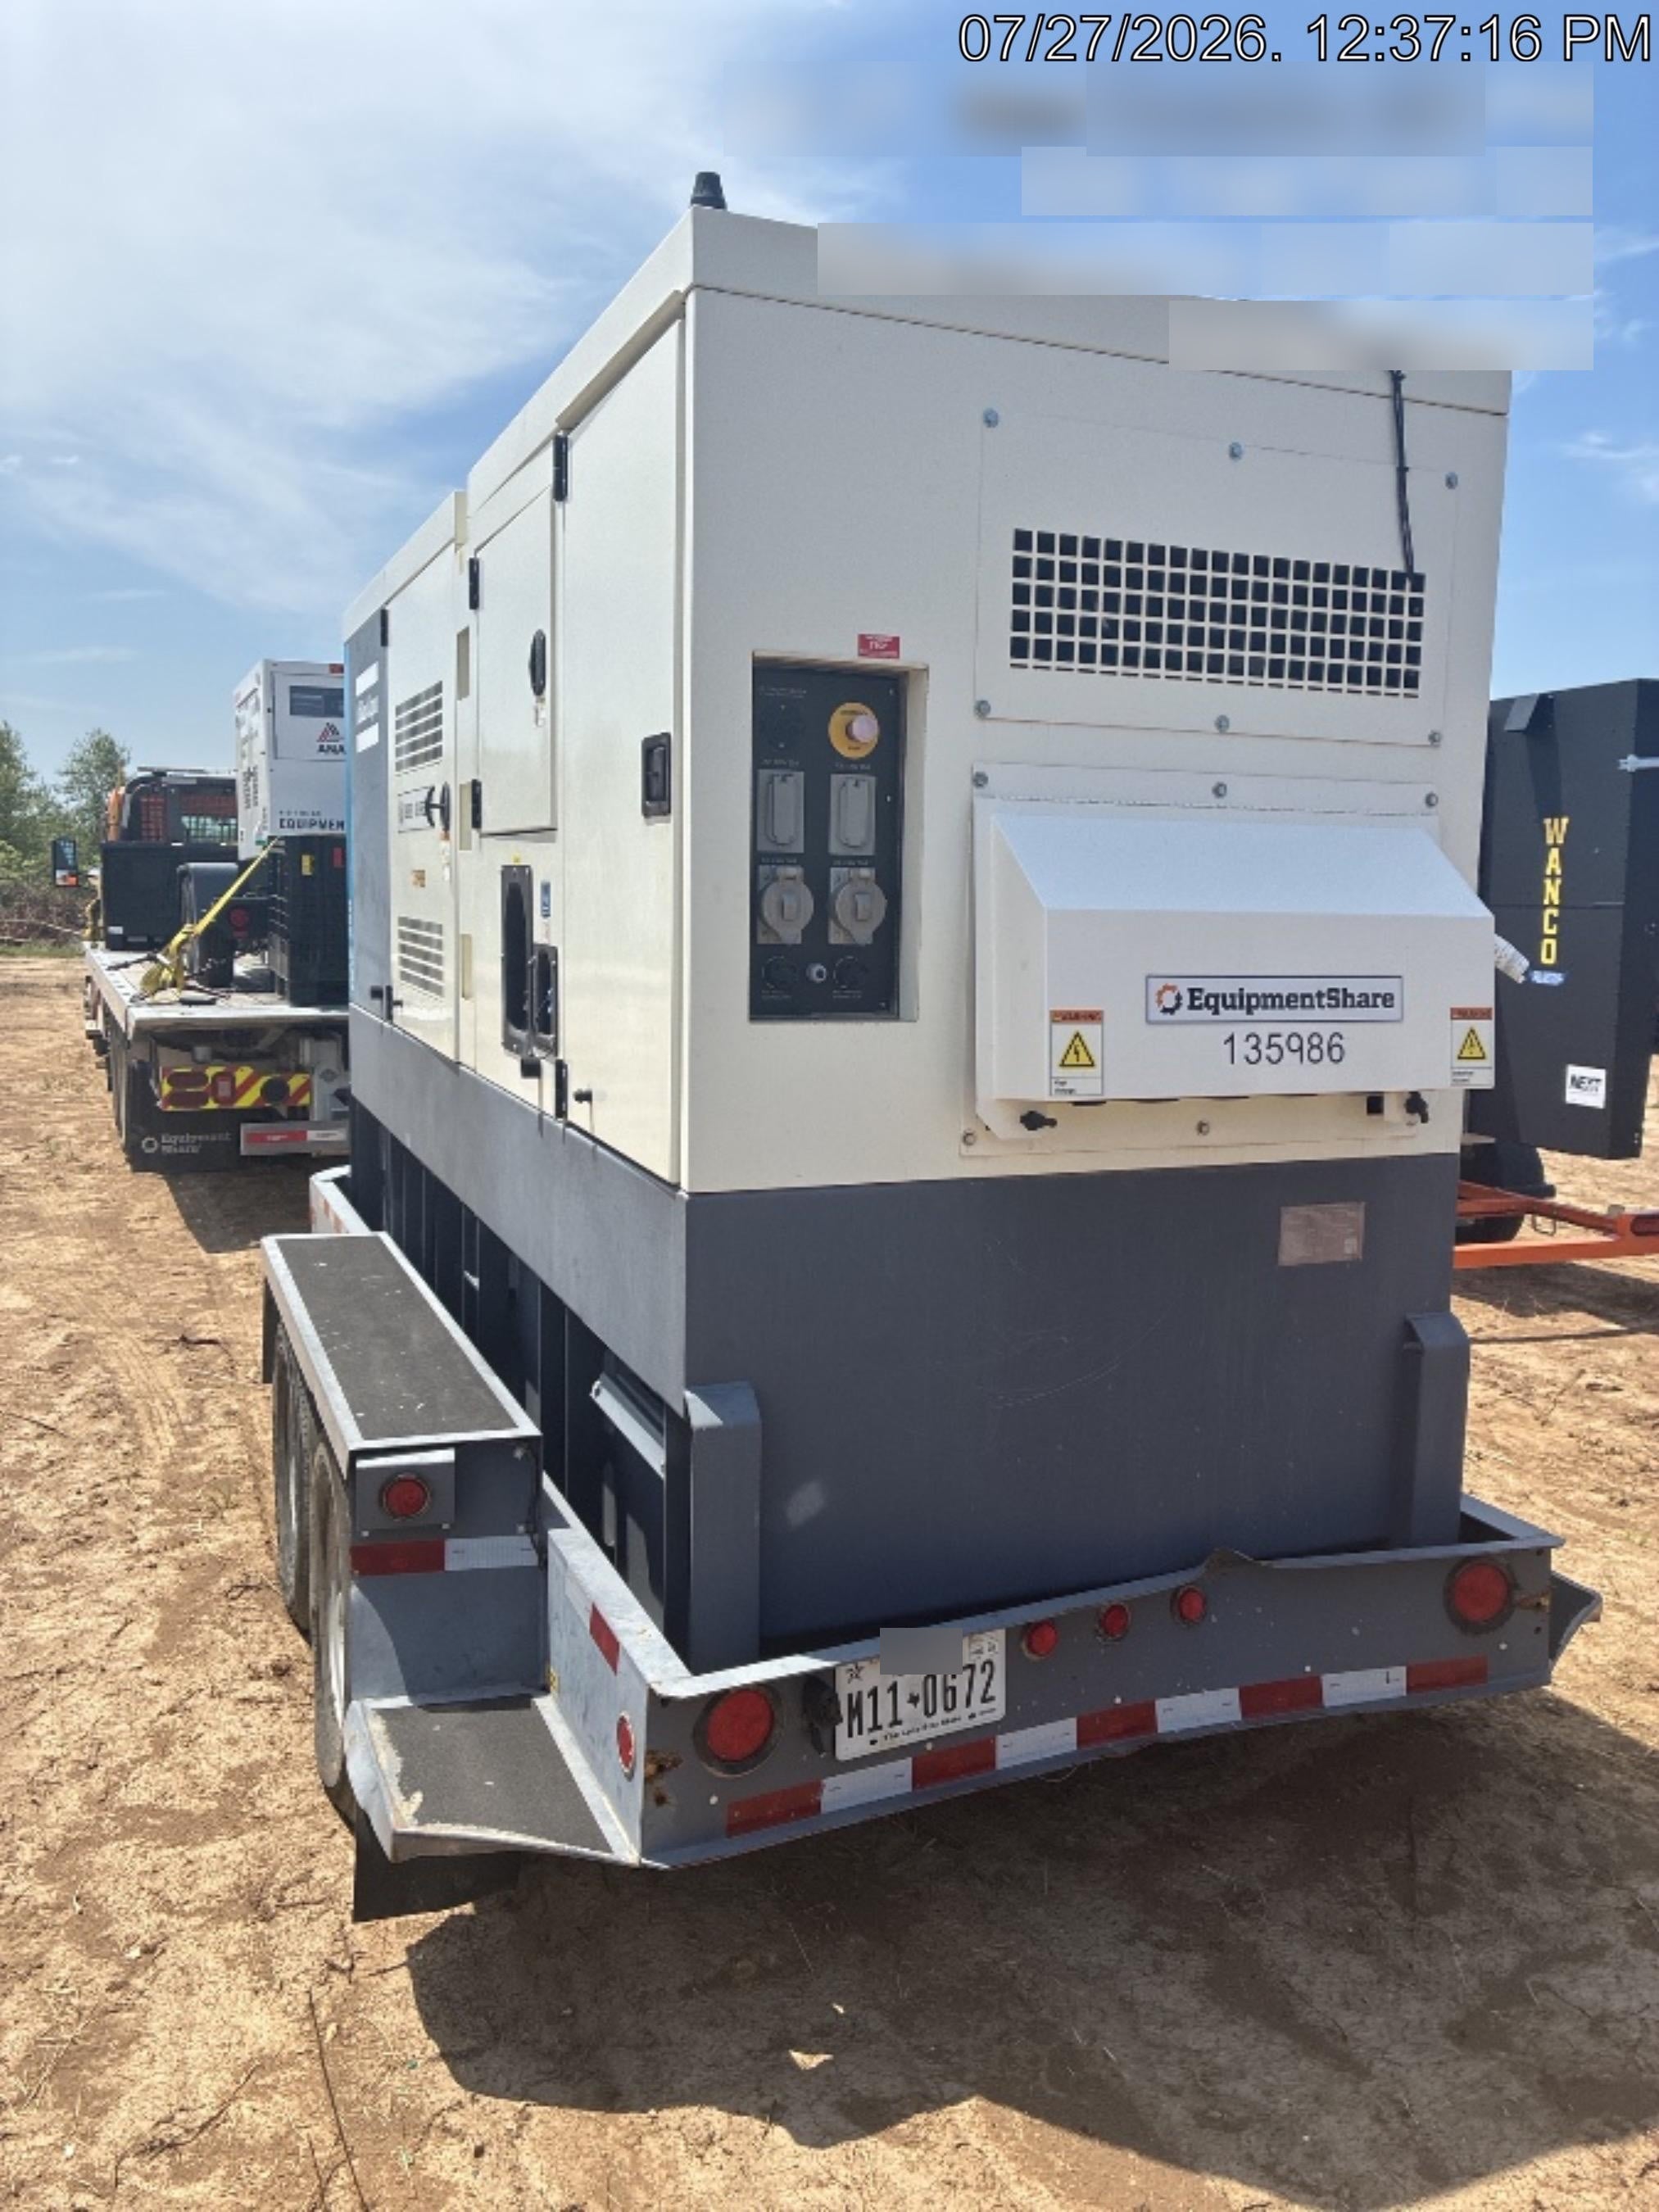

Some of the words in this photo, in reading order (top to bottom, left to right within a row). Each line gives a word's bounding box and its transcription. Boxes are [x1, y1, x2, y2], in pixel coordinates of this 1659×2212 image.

[1539, 816, 1570, 965] WANCO
[1186, 987, 1395, 1016] EquipmentShare
[1223, 1031, 1346, 1065] 135986
